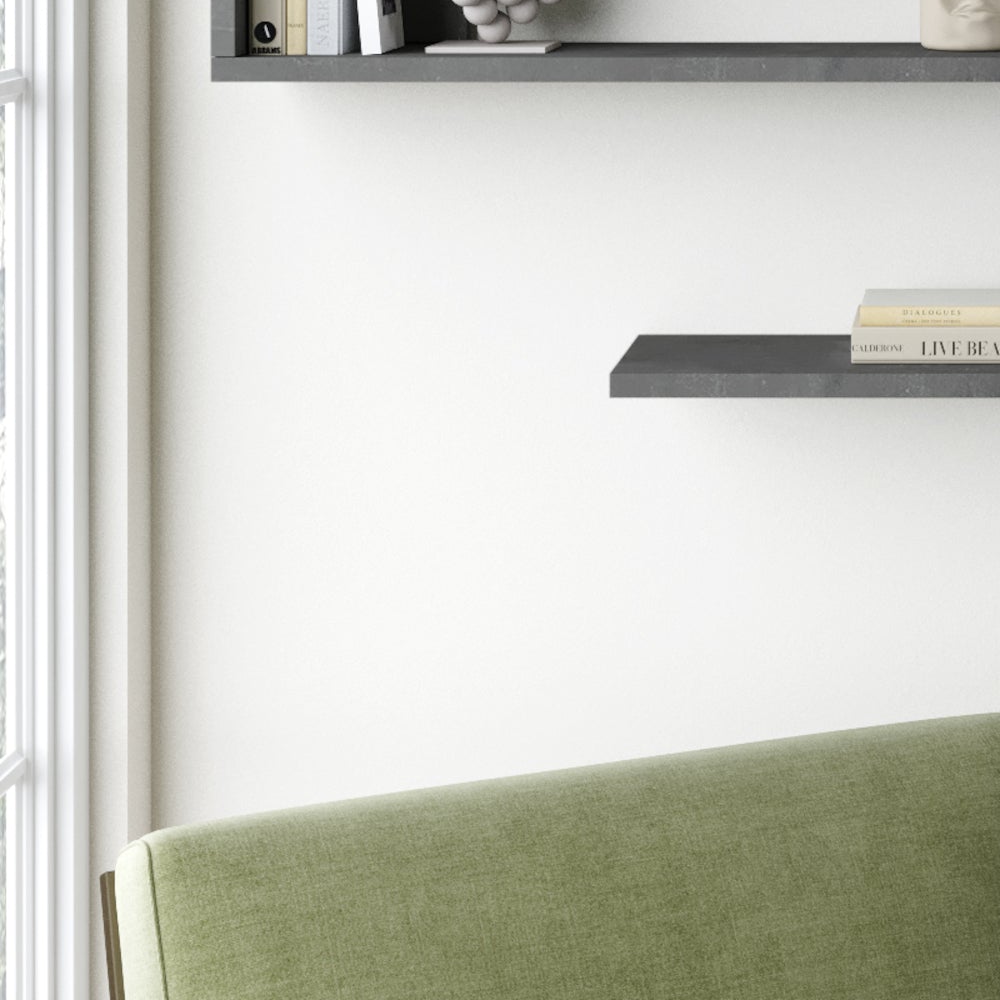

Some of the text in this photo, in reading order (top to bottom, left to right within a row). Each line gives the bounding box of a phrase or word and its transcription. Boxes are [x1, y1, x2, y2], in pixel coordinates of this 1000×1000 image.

[251, 46, 281, 55] ABRAMS
[851, 344, 904, 352] CALDERONE
[922, 341, 962, 356] LIVE
